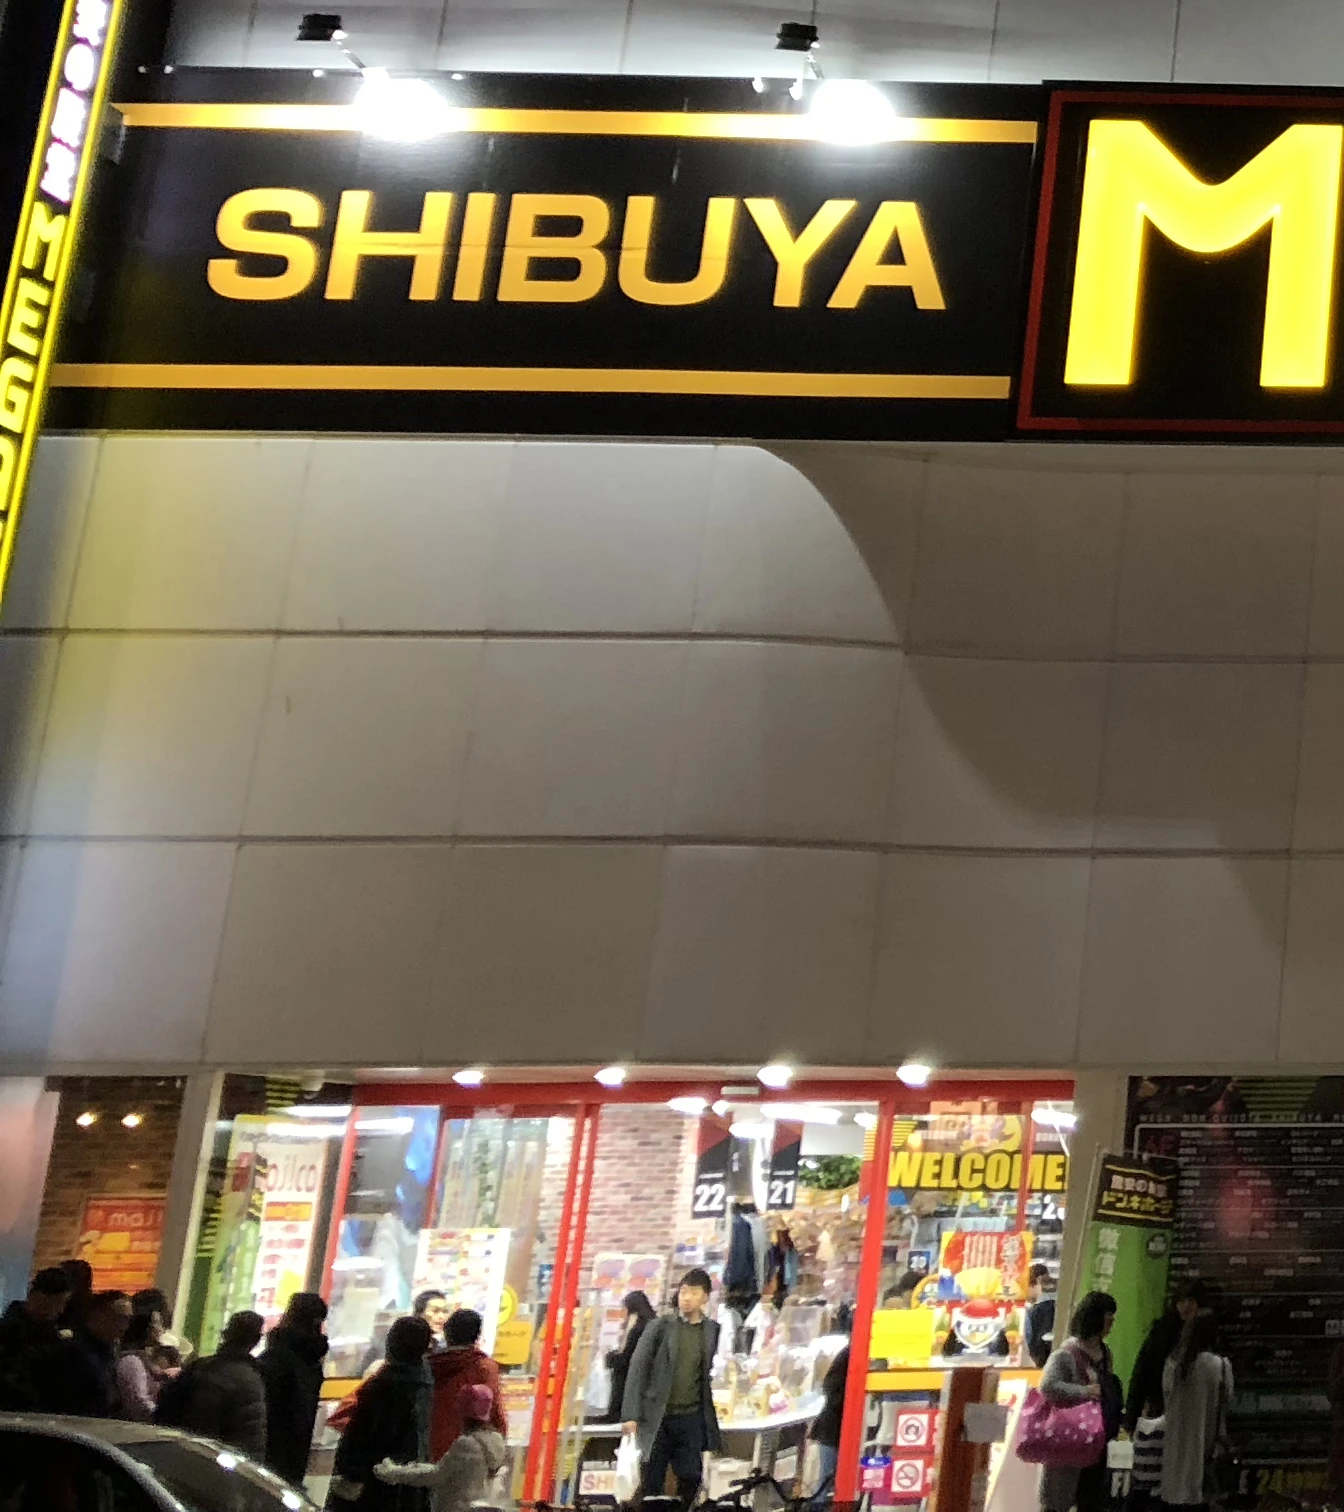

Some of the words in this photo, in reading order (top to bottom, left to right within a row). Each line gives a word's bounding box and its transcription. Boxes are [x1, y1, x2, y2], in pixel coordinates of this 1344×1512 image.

[207, 187, 946, 311] SHIBUYA
[888, 1150, 1065, 1190] WELCOME
[694, 1183, 726, 1212] 22
[768, 1180, 796, 1205] 21
